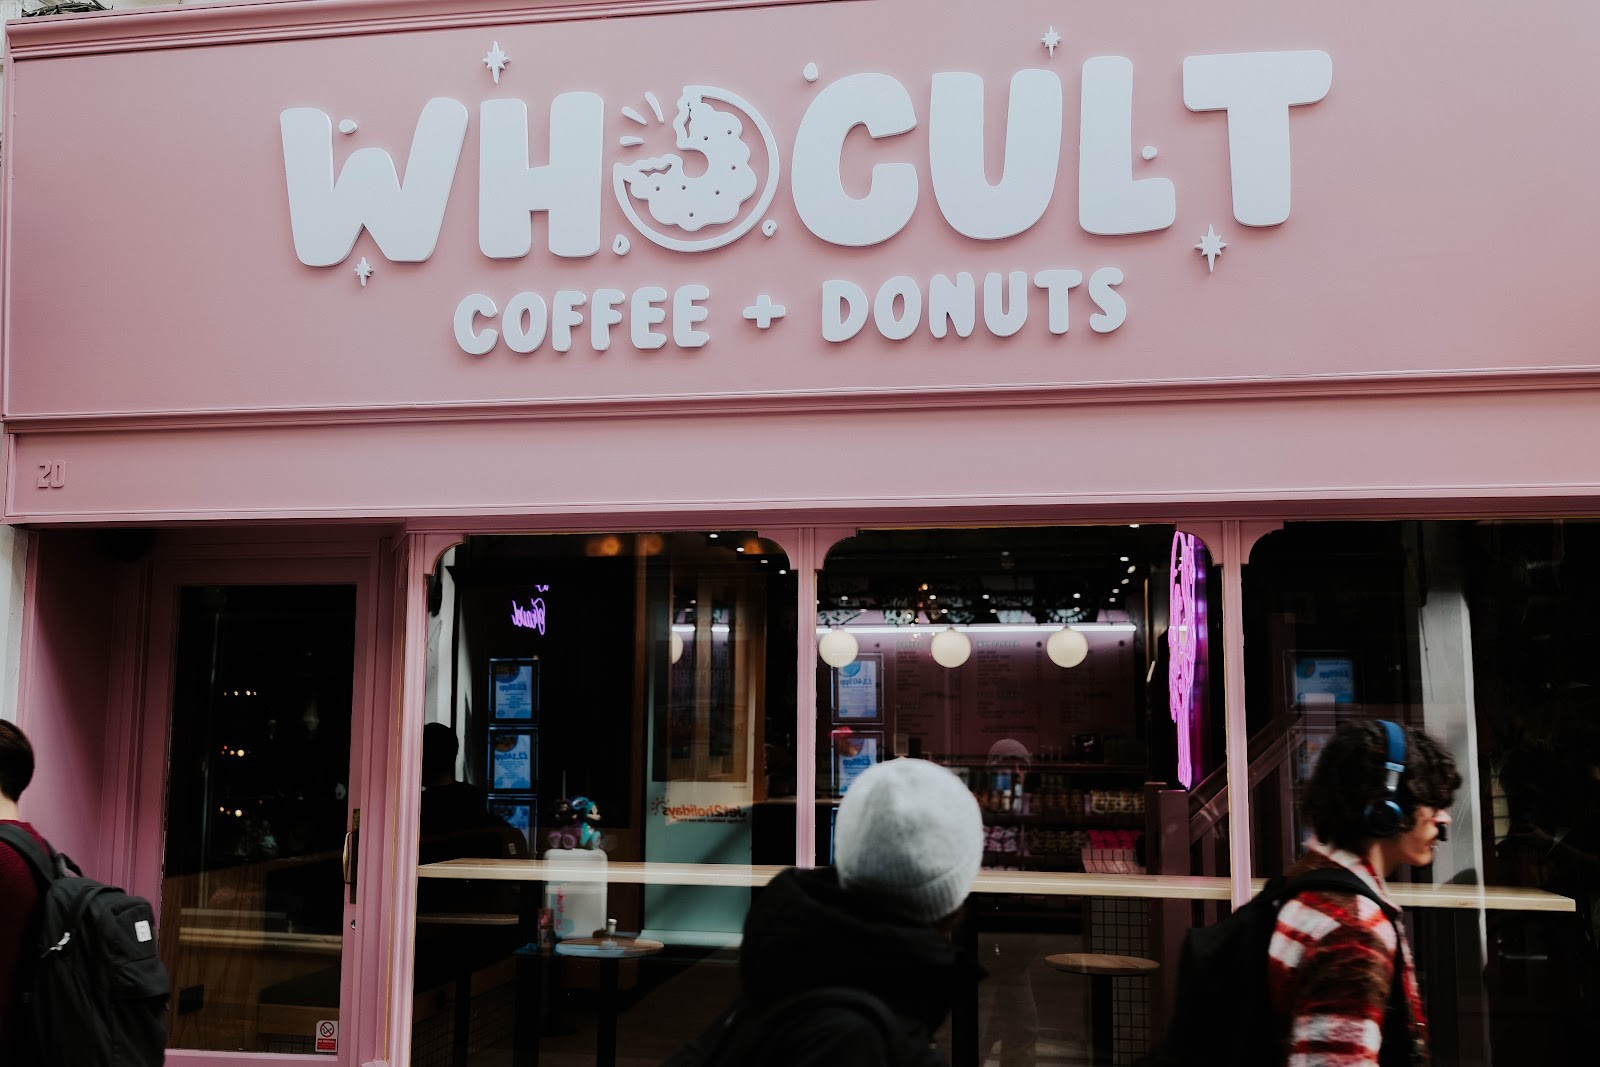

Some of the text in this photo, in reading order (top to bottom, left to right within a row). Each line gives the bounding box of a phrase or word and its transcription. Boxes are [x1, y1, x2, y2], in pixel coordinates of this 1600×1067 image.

[453, 285, 709, 355] COFFEE
[822, 267, 1127, 342] DONUTS
[37, 460, 66, 489] 20
